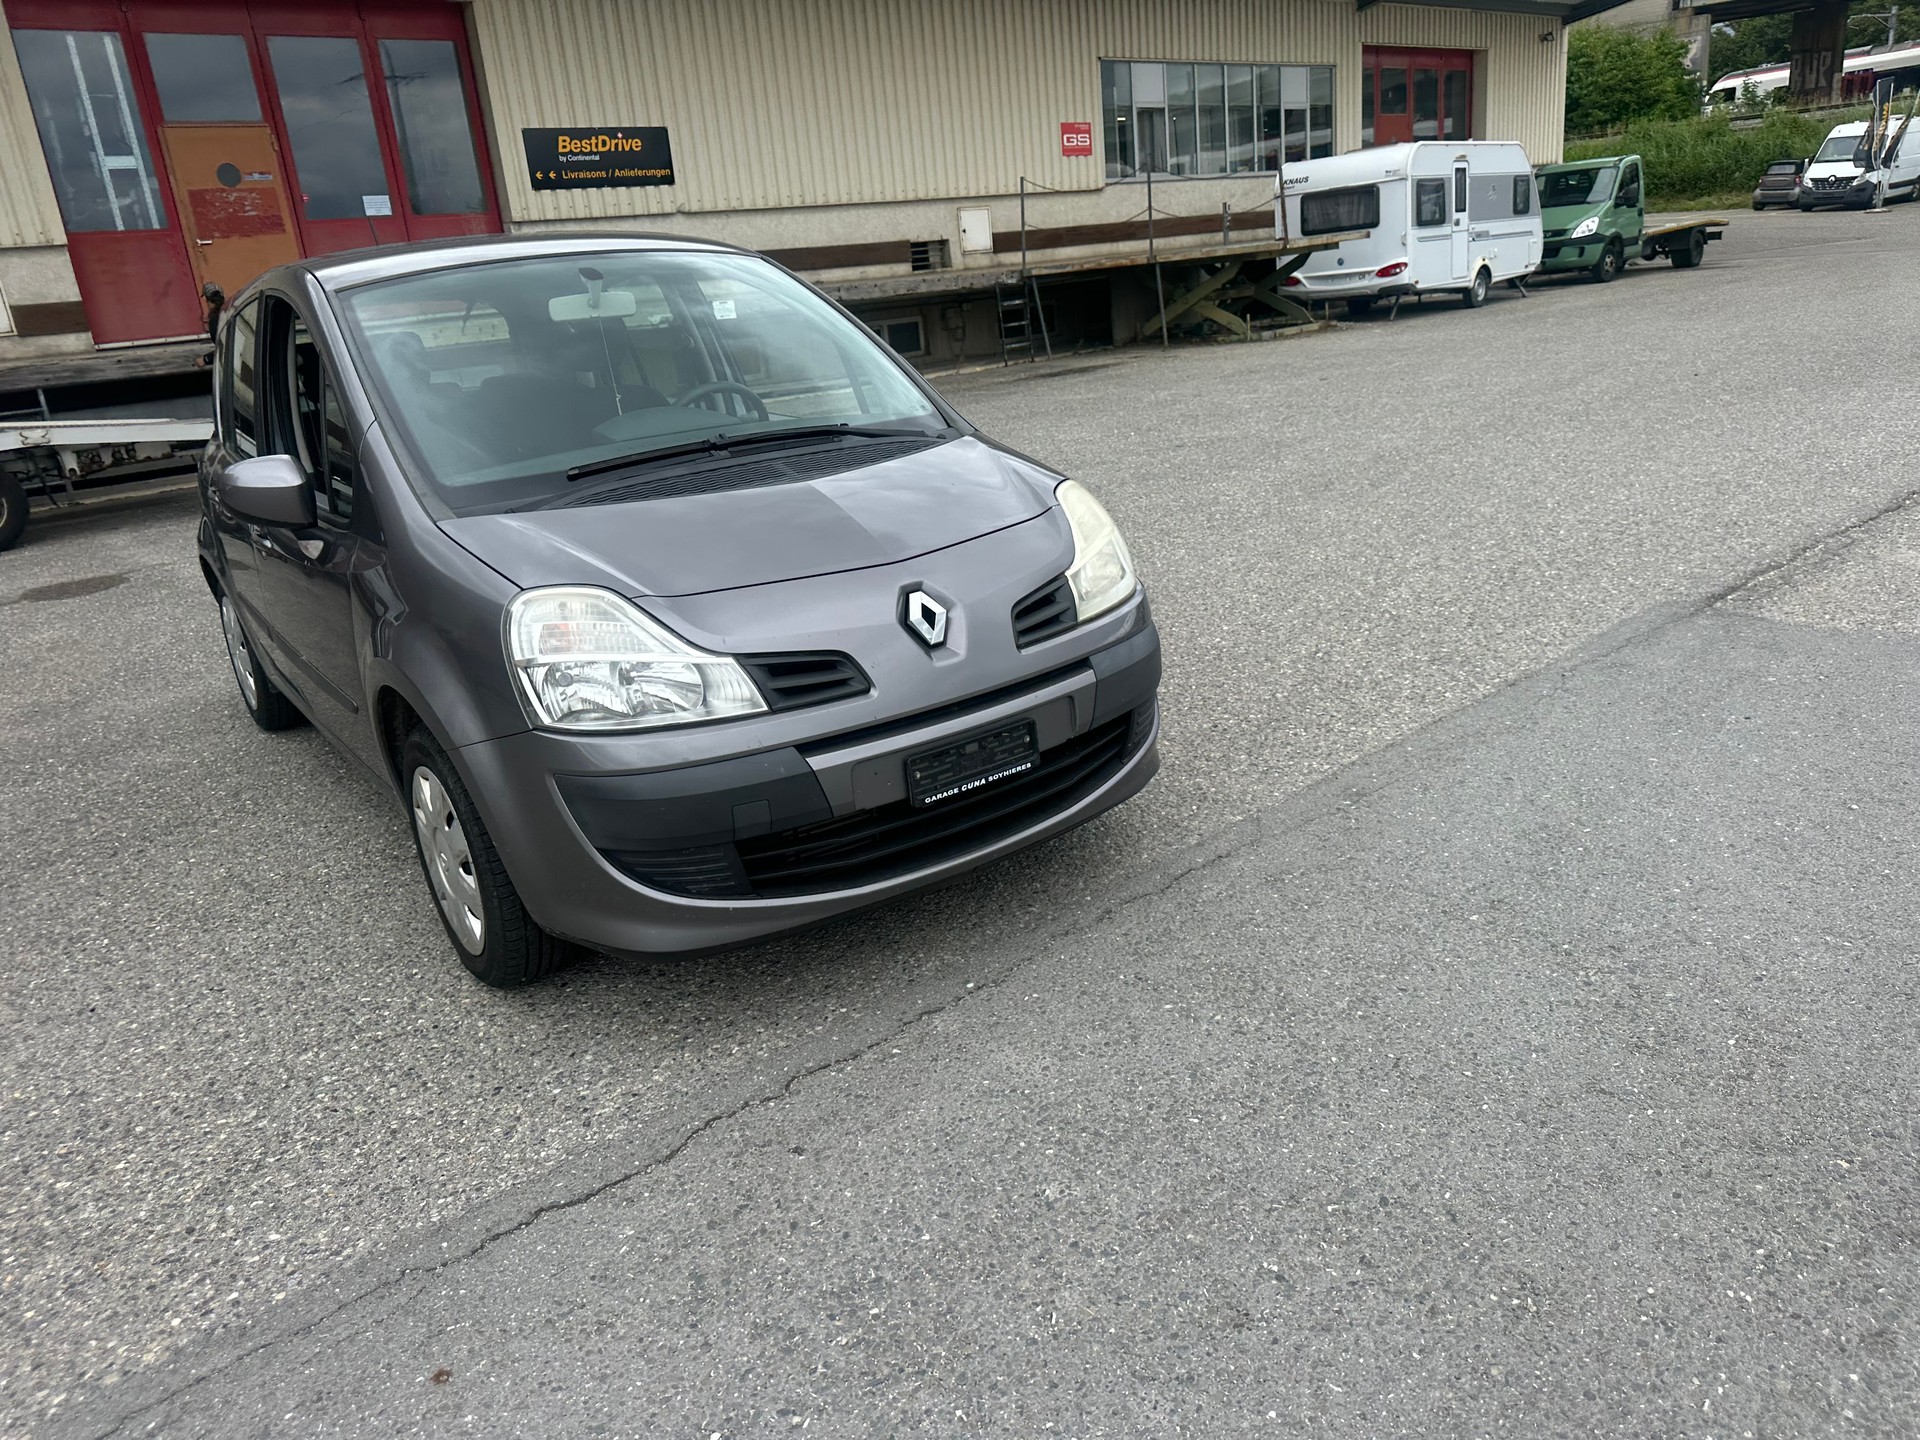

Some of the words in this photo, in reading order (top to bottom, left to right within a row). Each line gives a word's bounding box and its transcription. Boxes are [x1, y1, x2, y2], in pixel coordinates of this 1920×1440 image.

[558, 133, 642, 153] BestDrive
[1063, 133, 1090, 146] GS
[559, 155, 567, 163] by
[567, 154, 600, 162] Continental
[562, 170, 607, 179] Livraisons
[614, 168, 671, 178] Anlieferungen
[1283, 176, 1309, 185] KNAUS
[924, 788, 959, 804] GARAGE
[961, 778, 986, 792] CUNA
[988, 762, 1032, 782] SOYHIERES
